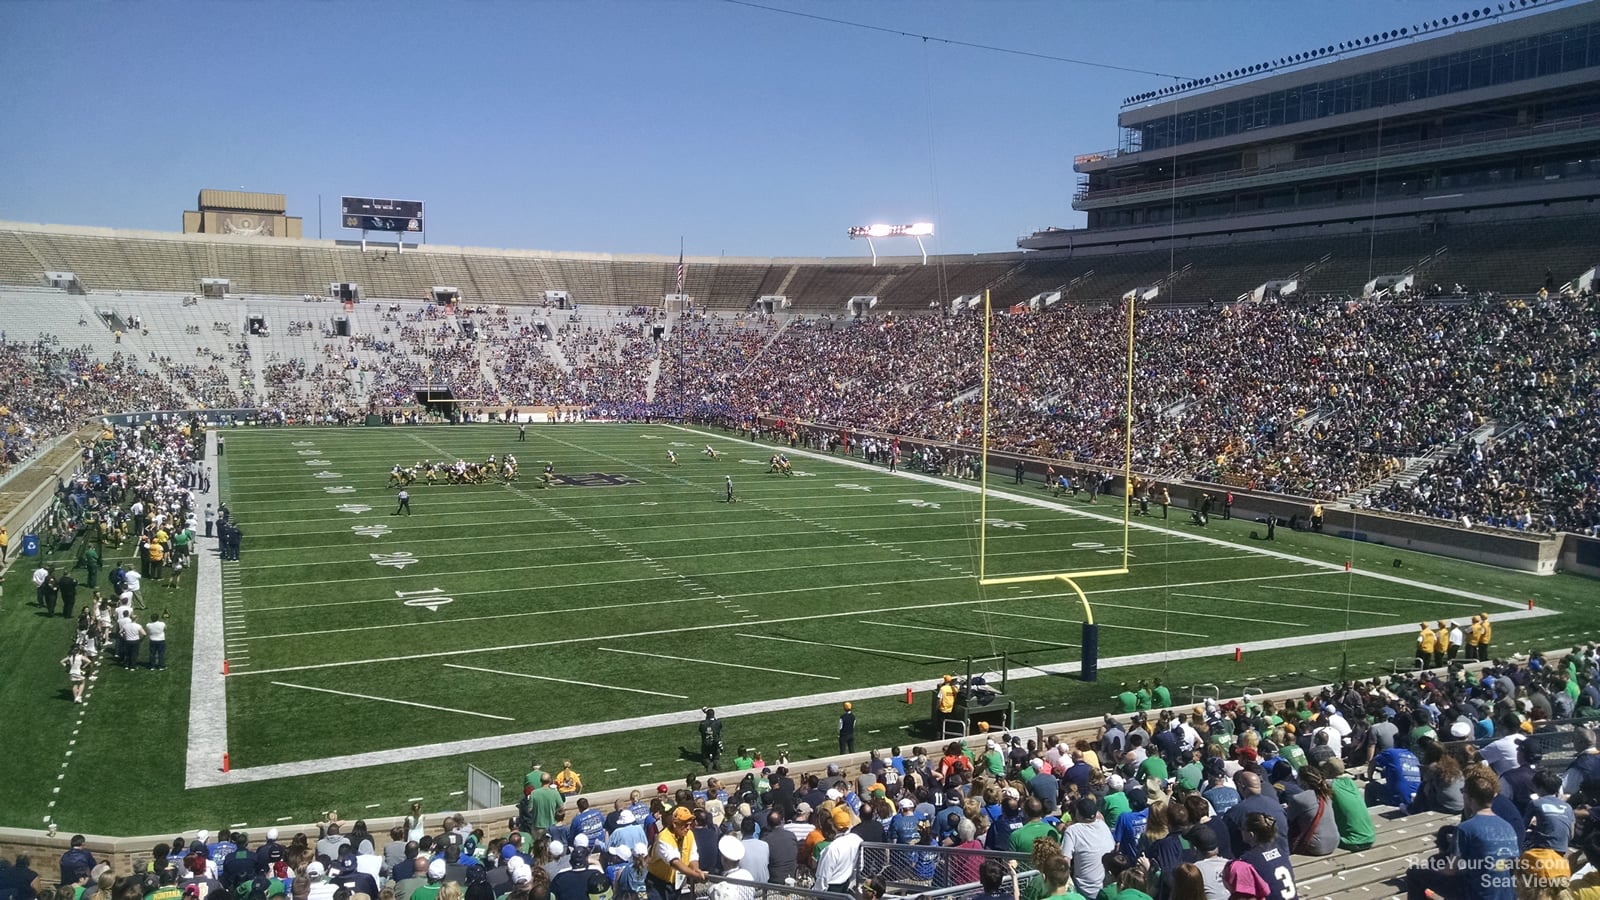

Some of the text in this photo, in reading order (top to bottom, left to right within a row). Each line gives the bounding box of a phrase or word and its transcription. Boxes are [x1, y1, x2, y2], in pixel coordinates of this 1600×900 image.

[369, 551, 419, 566] 20
[394, 587, 454, 607] 10
[934, 791, 943, 806] 11
[1274, 866, 1296, 900] 3
